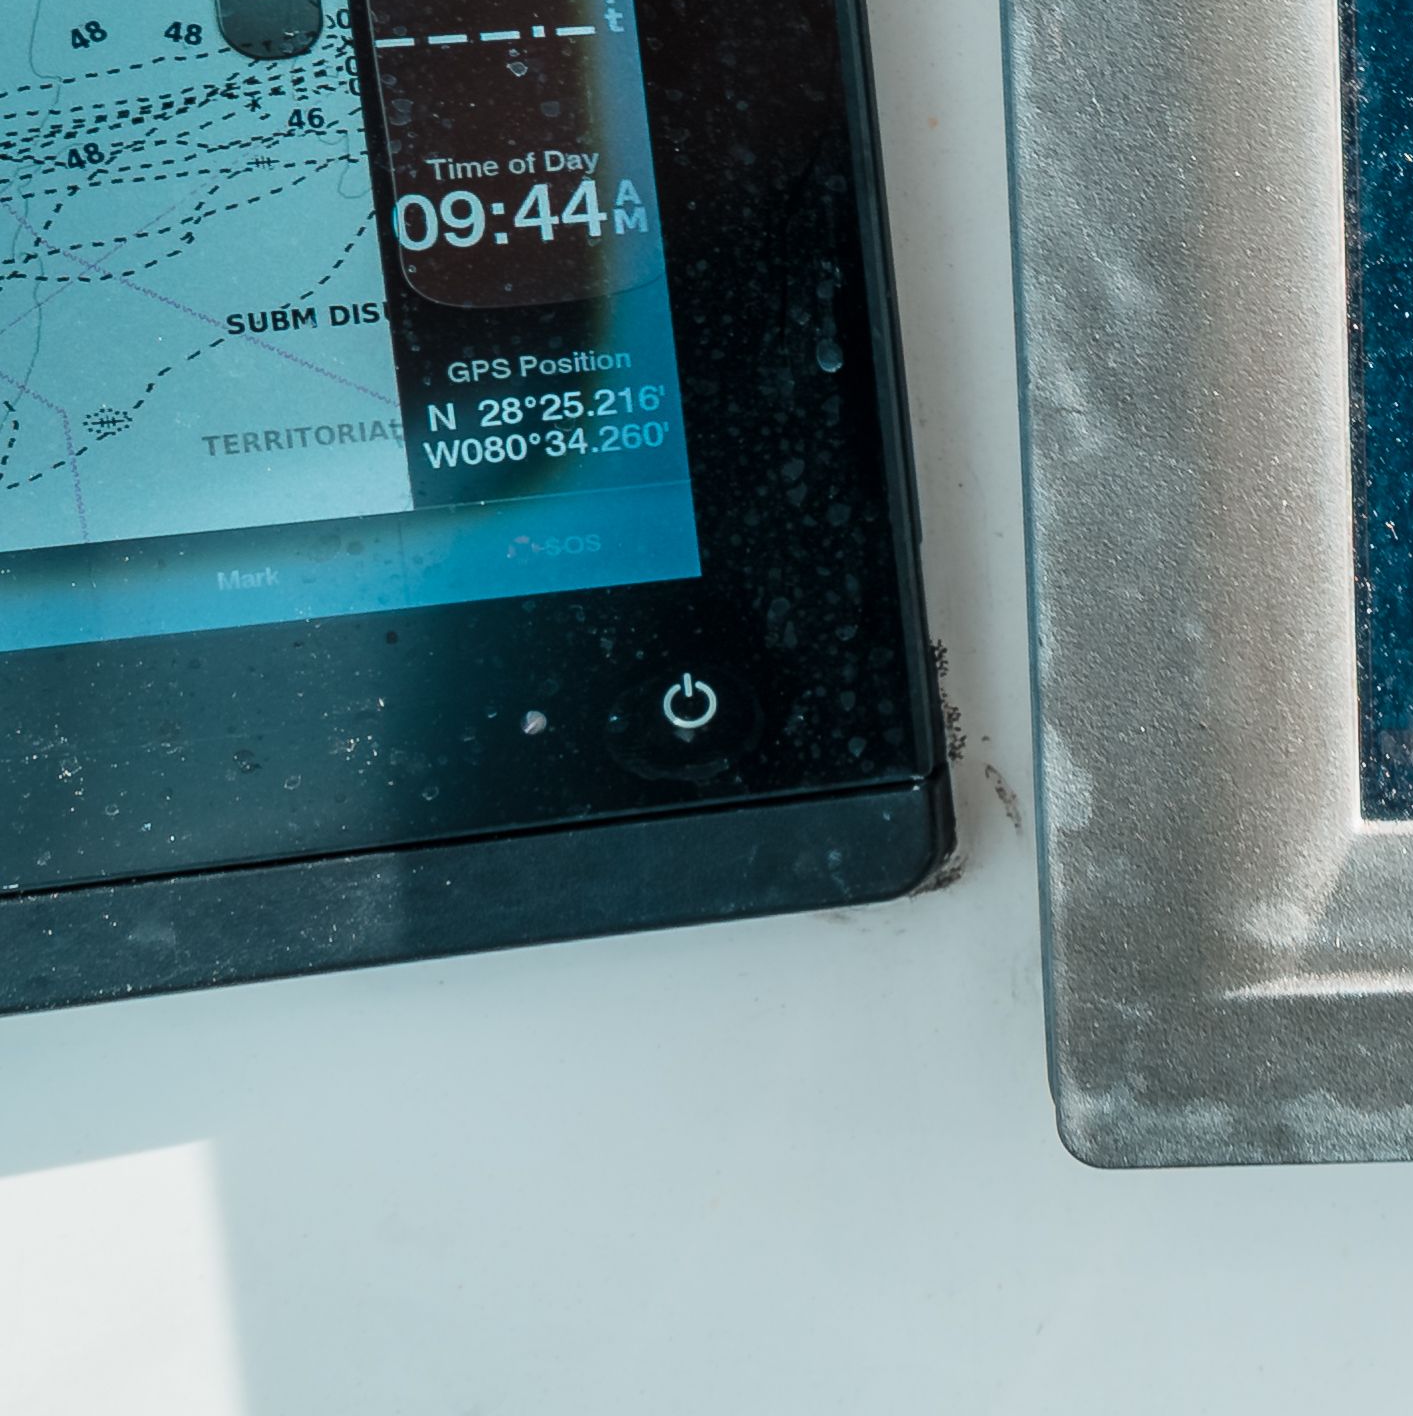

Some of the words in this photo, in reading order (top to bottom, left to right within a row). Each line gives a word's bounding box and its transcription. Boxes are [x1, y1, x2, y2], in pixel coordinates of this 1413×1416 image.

[71, 21, 108, 49] 48
[164, 22, 203, 45] 48
[288, 107, 325, 130] 46
[68, 143, 105, 169] 48
[424, 158, 499, 181] Time
[508, 152, 536, 175] of
[544, 150, 600, 174] Day
[392, 180, 608, 251] 09:44
[226, 305, 319, 335] SUBM
[329, 301, 391, 327] DIS
[447, 358, 512, 383] GPS
[519, 350, 632, 377] Position
[428, 402, 457, 432] N
[217, 567, 279, 591] Mark
